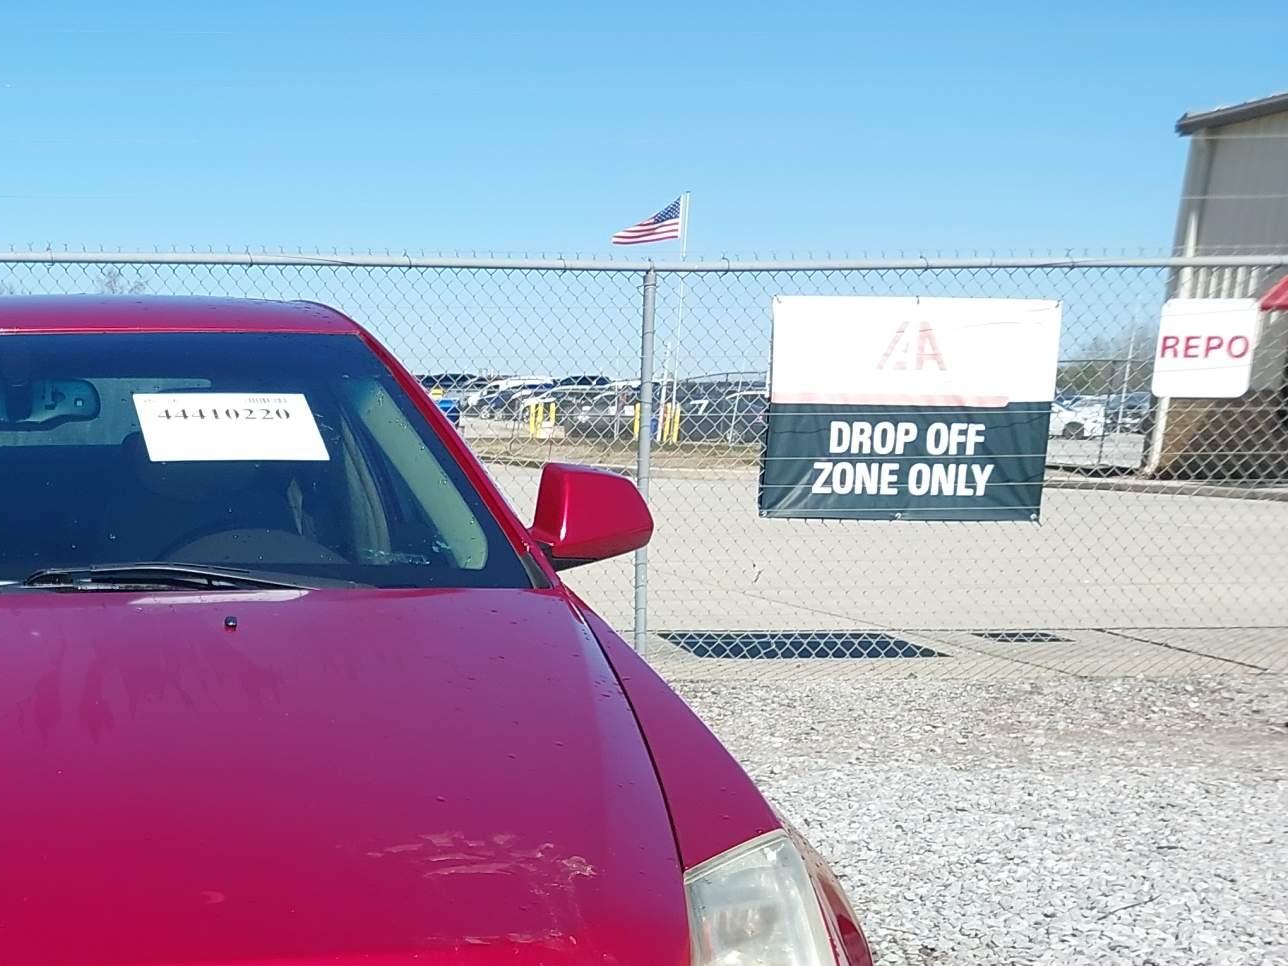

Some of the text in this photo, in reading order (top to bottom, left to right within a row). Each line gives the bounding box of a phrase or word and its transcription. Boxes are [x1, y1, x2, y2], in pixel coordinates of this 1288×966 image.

[1159, 334, 1250, 360] REPO
[157, 407, 291, 421] 44410220
[828, 420, 986, 456] DROP OFF
[811, 461, 995, 497] ZONE ONLY
